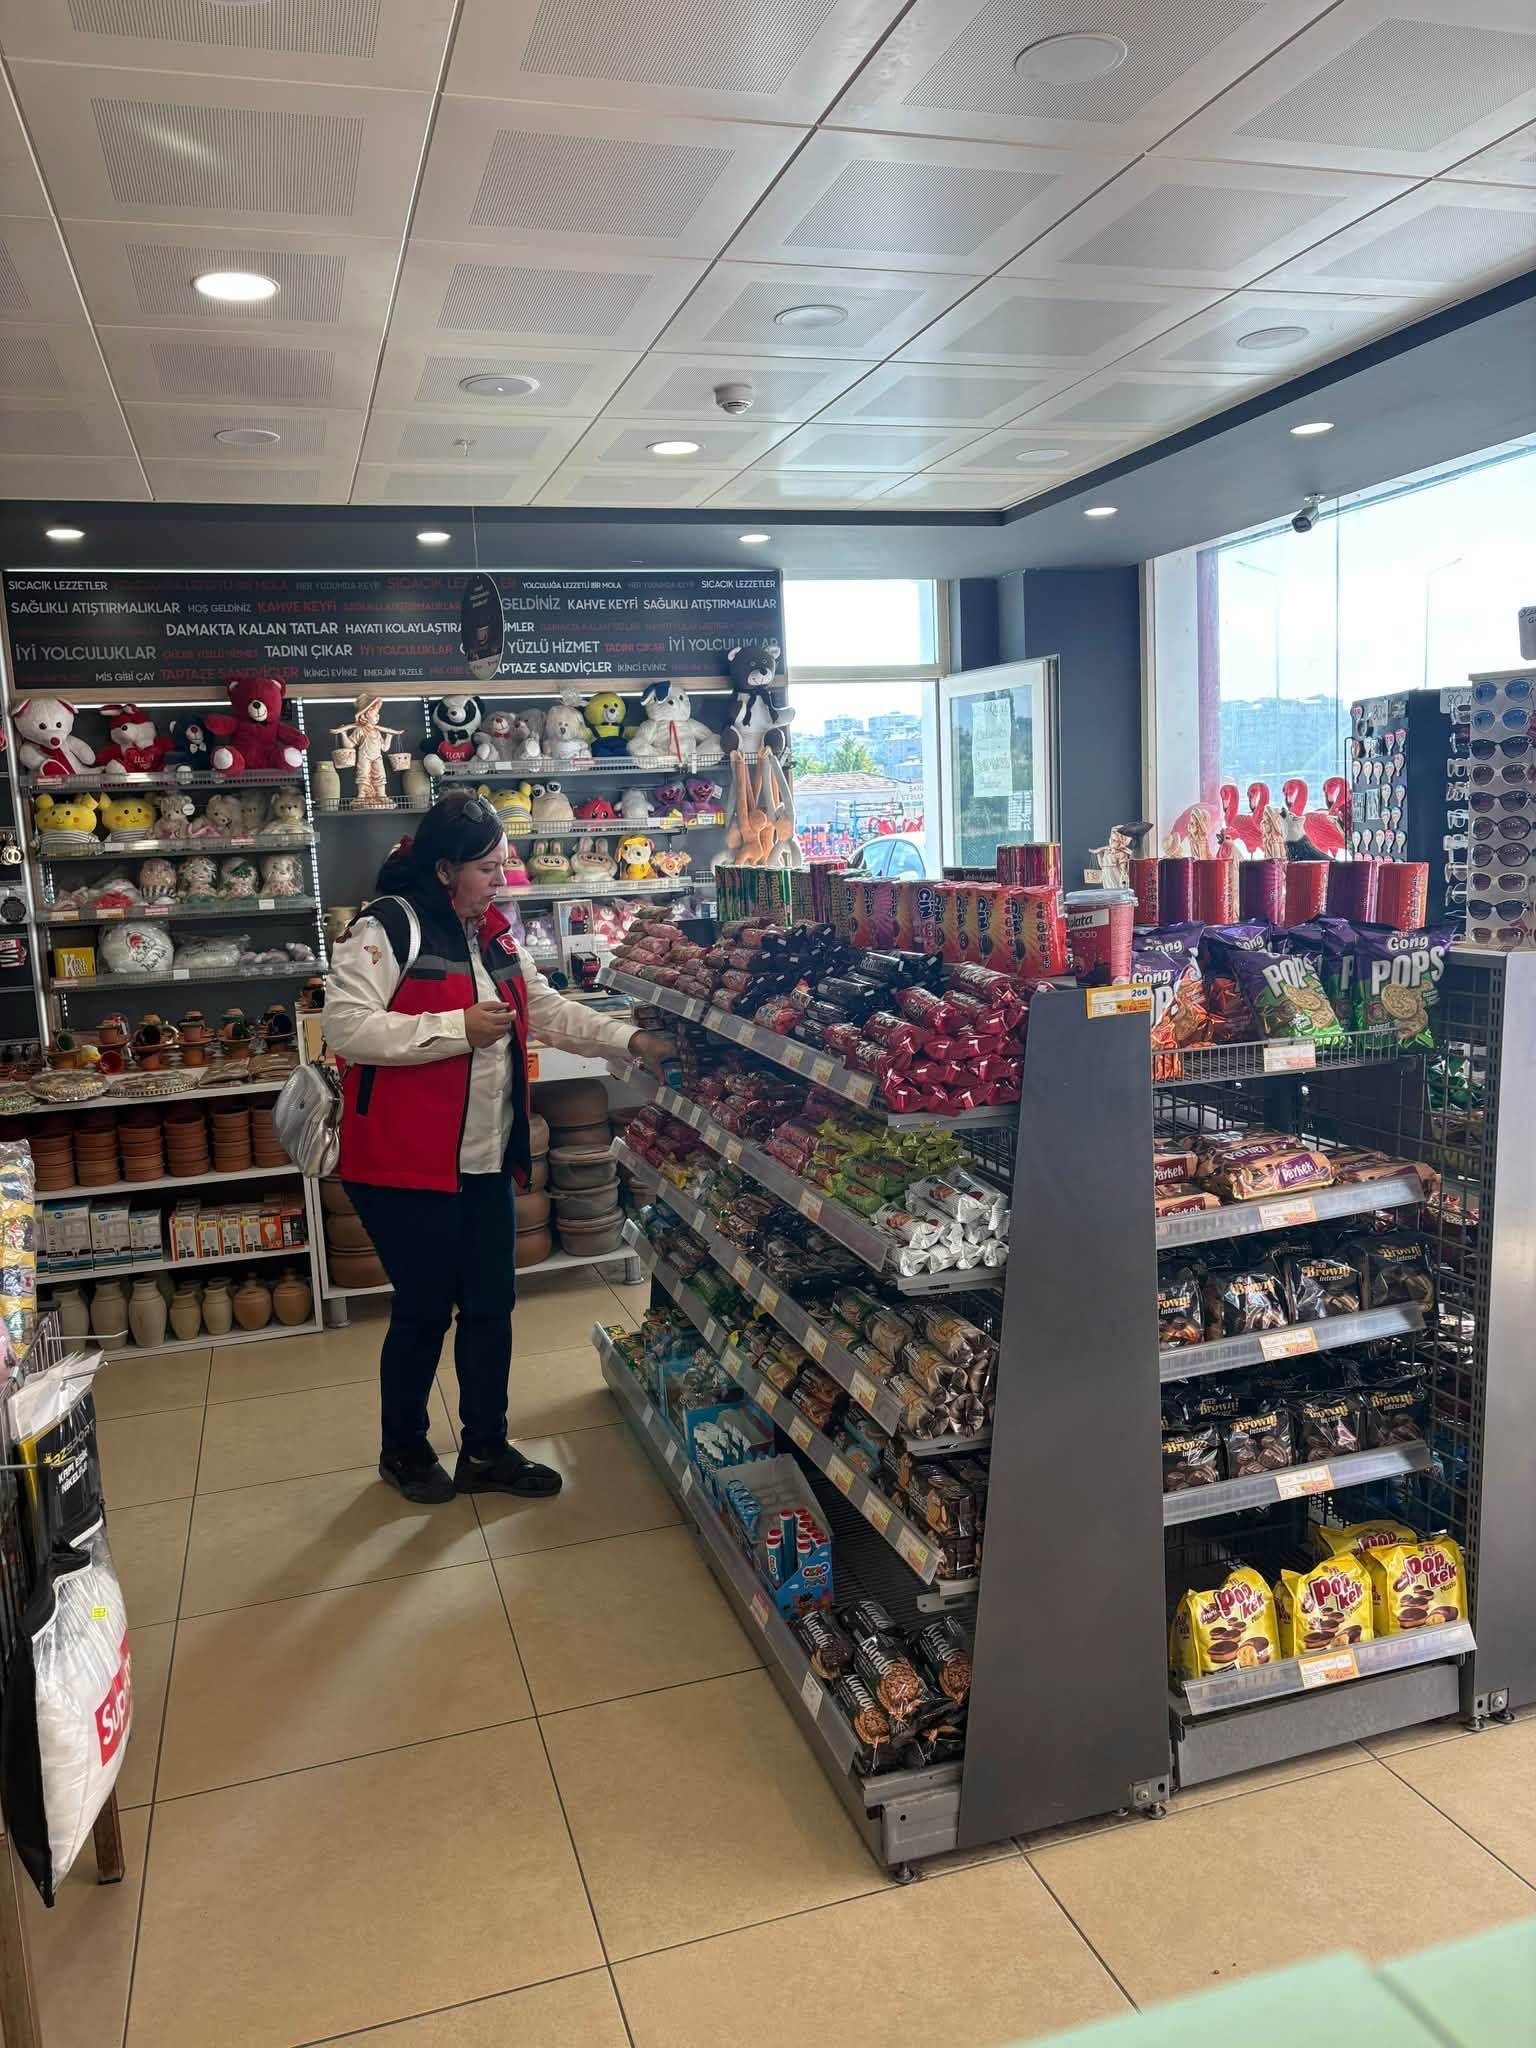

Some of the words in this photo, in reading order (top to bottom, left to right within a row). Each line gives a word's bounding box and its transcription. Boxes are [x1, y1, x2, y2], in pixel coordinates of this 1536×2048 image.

[8, 581, 51, 590] SICACIK
[54, 581, 108, 590] LEZZETLER
[701, 580, 733, 589] SICACIK
[735, 580, 776, 589] LEZZETLER
[11, 600, 68, 614] SAĞLIKLI
[72, 602, 181, 616] ATIŞTIRMALIKLAR
[188, 604, 208, 614] HOŞ
[210, 603, 252, 613] GELDİNİZ
[502, 595, 560, 610] GELDİNİZ
[567, 600, 607, 610] KAHVE
[609, 597, 638, 610] KEYFİ
[643, 597, 688, 610] SAĞLIKLI
[691, 600, 777, 611] ATIŞTIRMALIKLAR
[166, 624, 235, 636] DAMAKTA
[239, 623, 287, 635] KALAN
[289, 622, 338, 635] TATLAR
[345, 623, 383, 634] HAYATI
[386, 622, 462, 635] KOLAYLAŞTIRA
[507, 639, 549, 654] YÜZLÜ
[552, 639, 600, 654] HİZMET
[668, 636, 685, 652] İYİ
[15, 644, 37, 661] İYİ
[41, 646, 157, 661] YOLCULUKLAR
[264, 645, 307, 657] TADINI
[310, 645, 353, 659] ÇIKAR
[495, 663, 537, 675] APTAZE
[540, 660, 612, 675] SANDVİÇLER
[1387, 935, 1429, 952] Gong
[1132, 969, 1172, 985] Gong
[1371, 945, 1445, 996] POPS
[1282, 1162, 1315, 1181] Paykek
[1303, 1263, 1350, 1278] Browni
[1157, 1295, 1183, 1309] rowni
[1231, 1412, 1278, 1432] Browni
[1406, 1553, 1445, 1583] pop
[1312, 1574, 1351, 1607] pop
